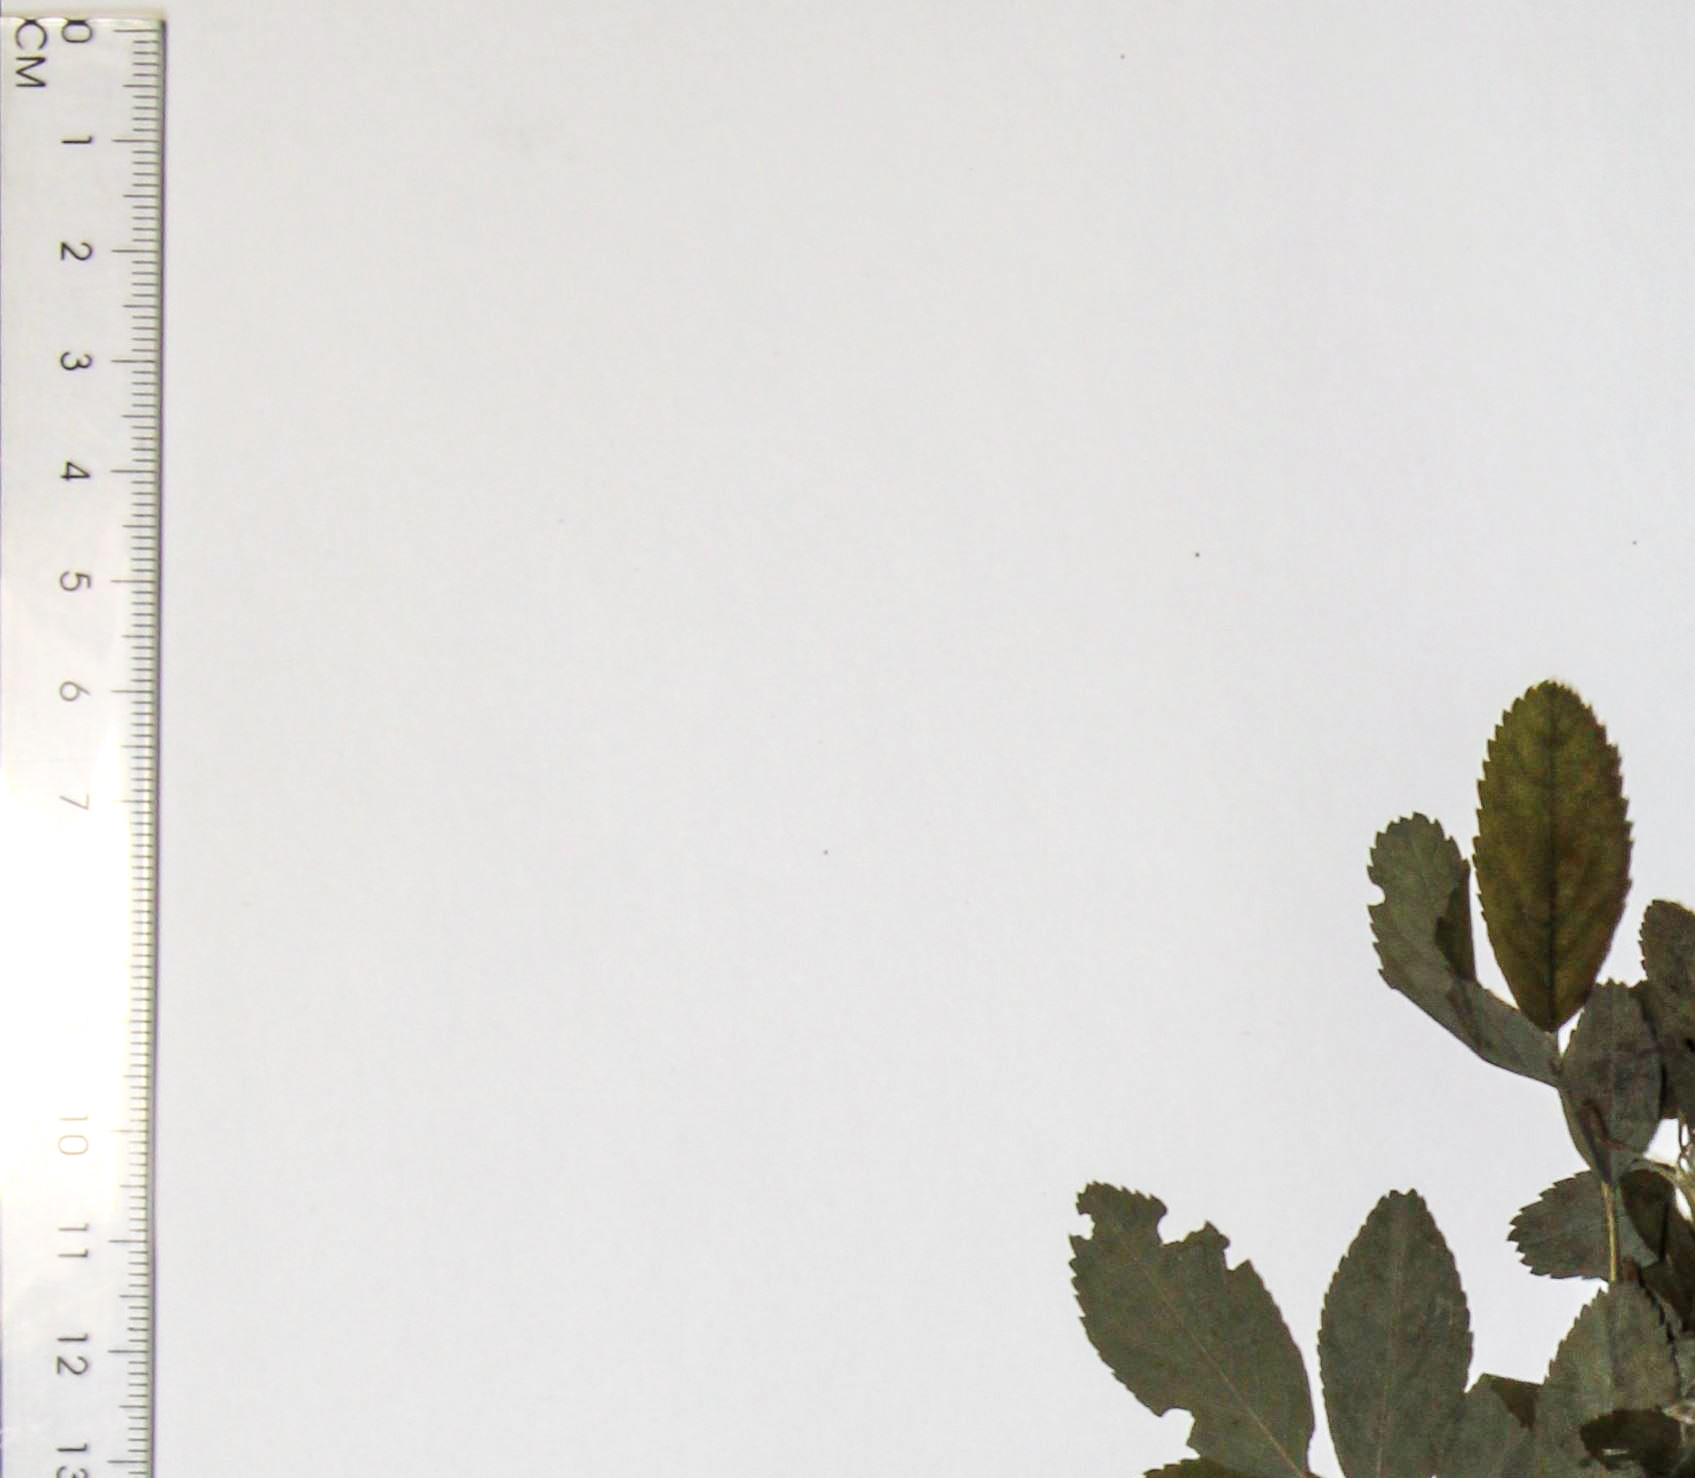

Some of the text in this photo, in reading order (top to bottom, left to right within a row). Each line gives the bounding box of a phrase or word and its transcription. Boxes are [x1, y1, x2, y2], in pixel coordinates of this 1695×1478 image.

[61, 19, 94, 44] 0
[15, 19, 48, 88] CM
[60, 133, 95, 145] 1
[56, 240, 96, 262] 2
[56, 350, 95, 372] 3
[59, 458, 92, 482] 4
[58, 569, 92, 592] 5
[57, 678, 91, 702] 6
[59, 793, 90, 811] 7
[56, 1114, 89, 1156] 10
[57, 1222, 92, 1260] 11
[52, 1332, 92, 1377] 12
